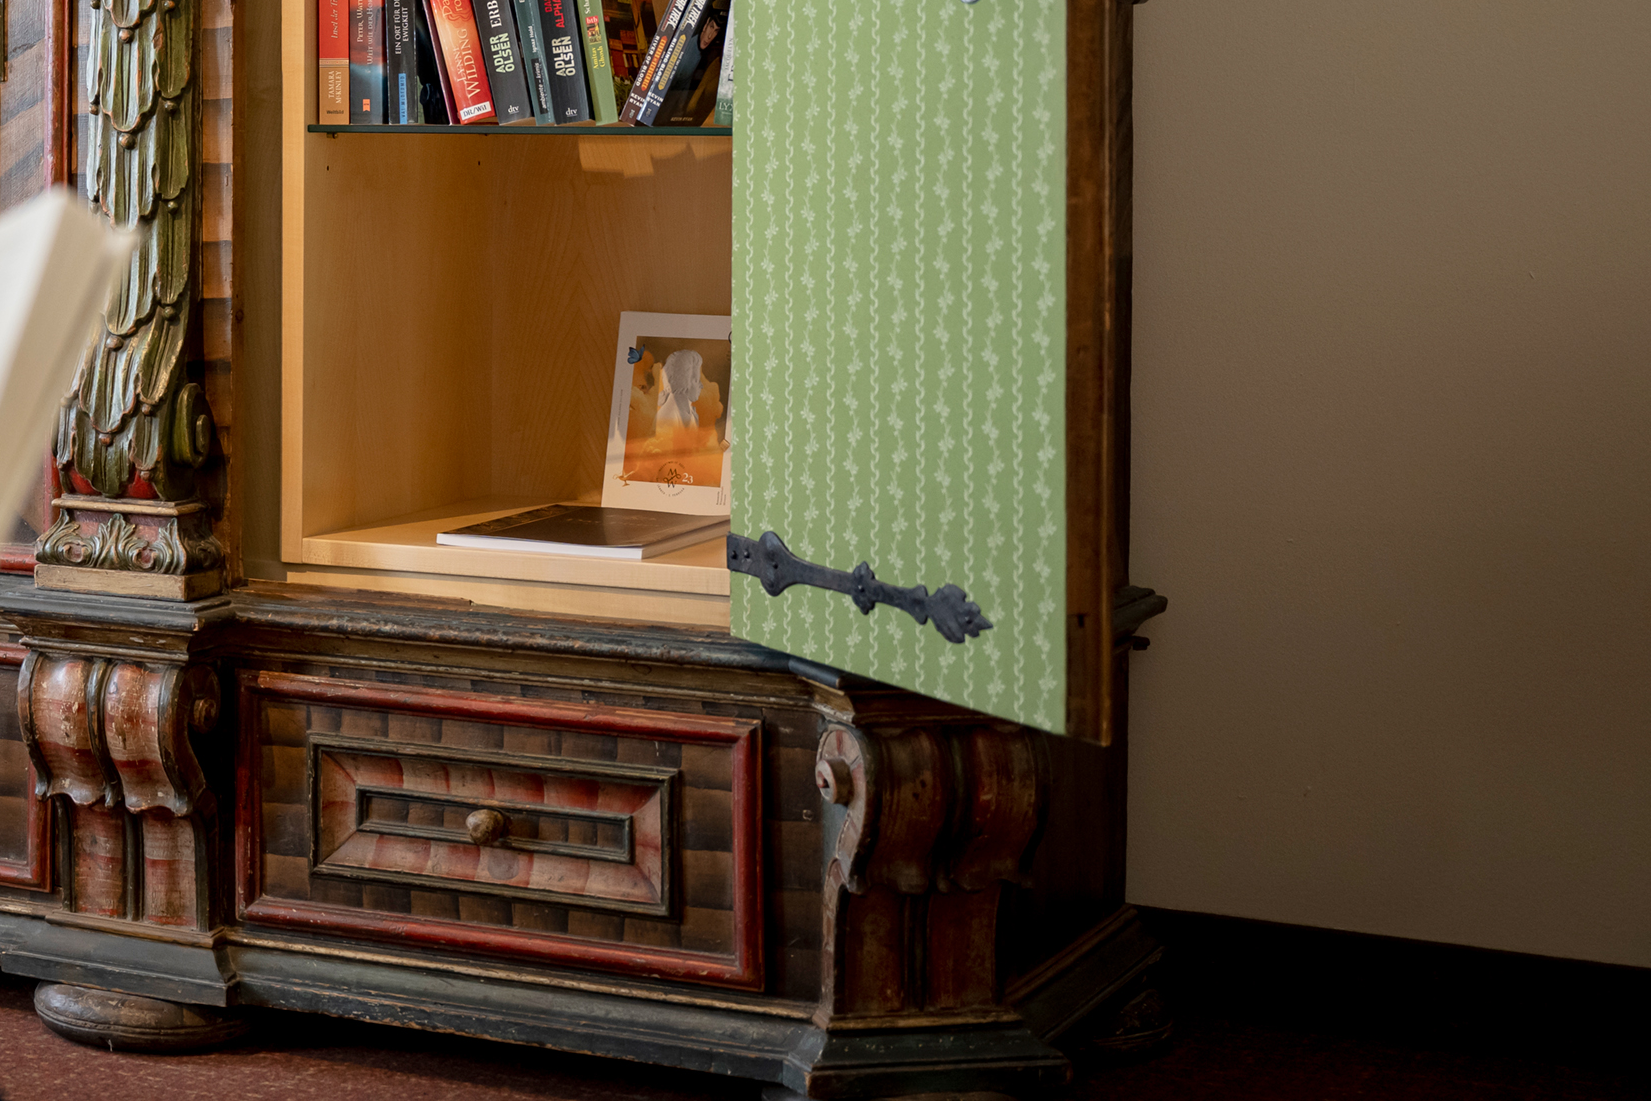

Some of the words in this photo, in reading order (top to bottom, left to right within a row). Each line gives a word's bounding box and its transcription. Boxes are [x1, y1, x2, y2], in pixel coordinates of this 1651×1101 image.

[330, 9, 338, 20] der
[393, 9, 401, 24] FÜR
[586, 16, 598, 24] btb
[667, 9, 682, 30] TREK
[687, 8, 702, 29] TREK
[489, 36, 506, 73] ADLER
[498, 32, 515, 72] OLSEN
[560, 36, 576, 76] OLSEN
[649, 36, 660, 56] RIVER
[663, 37, 677, 62] KILLING
[457, 28, 481, 99] WILDING
[551, 38, 567, 77] ADLER
[591, 47, 599, 69] Amitav
[597, 45, 606, 68] Ghosh
[645, 55, 652, 64] OF
[534, 62, 542, 79] krimis
[635, 65, 648, 87] BLOOD
[655, 63, 666, 82] BLOW
[538, 83, 547, 109] ambiente
[646, 97, 661, 108] RYAN
[648, 91, 664, 103] KEVIN
[508, 104, 519, 114] dtv
[565, 107, 578, 116] dtv
[682, 472, 694, 484] 23
